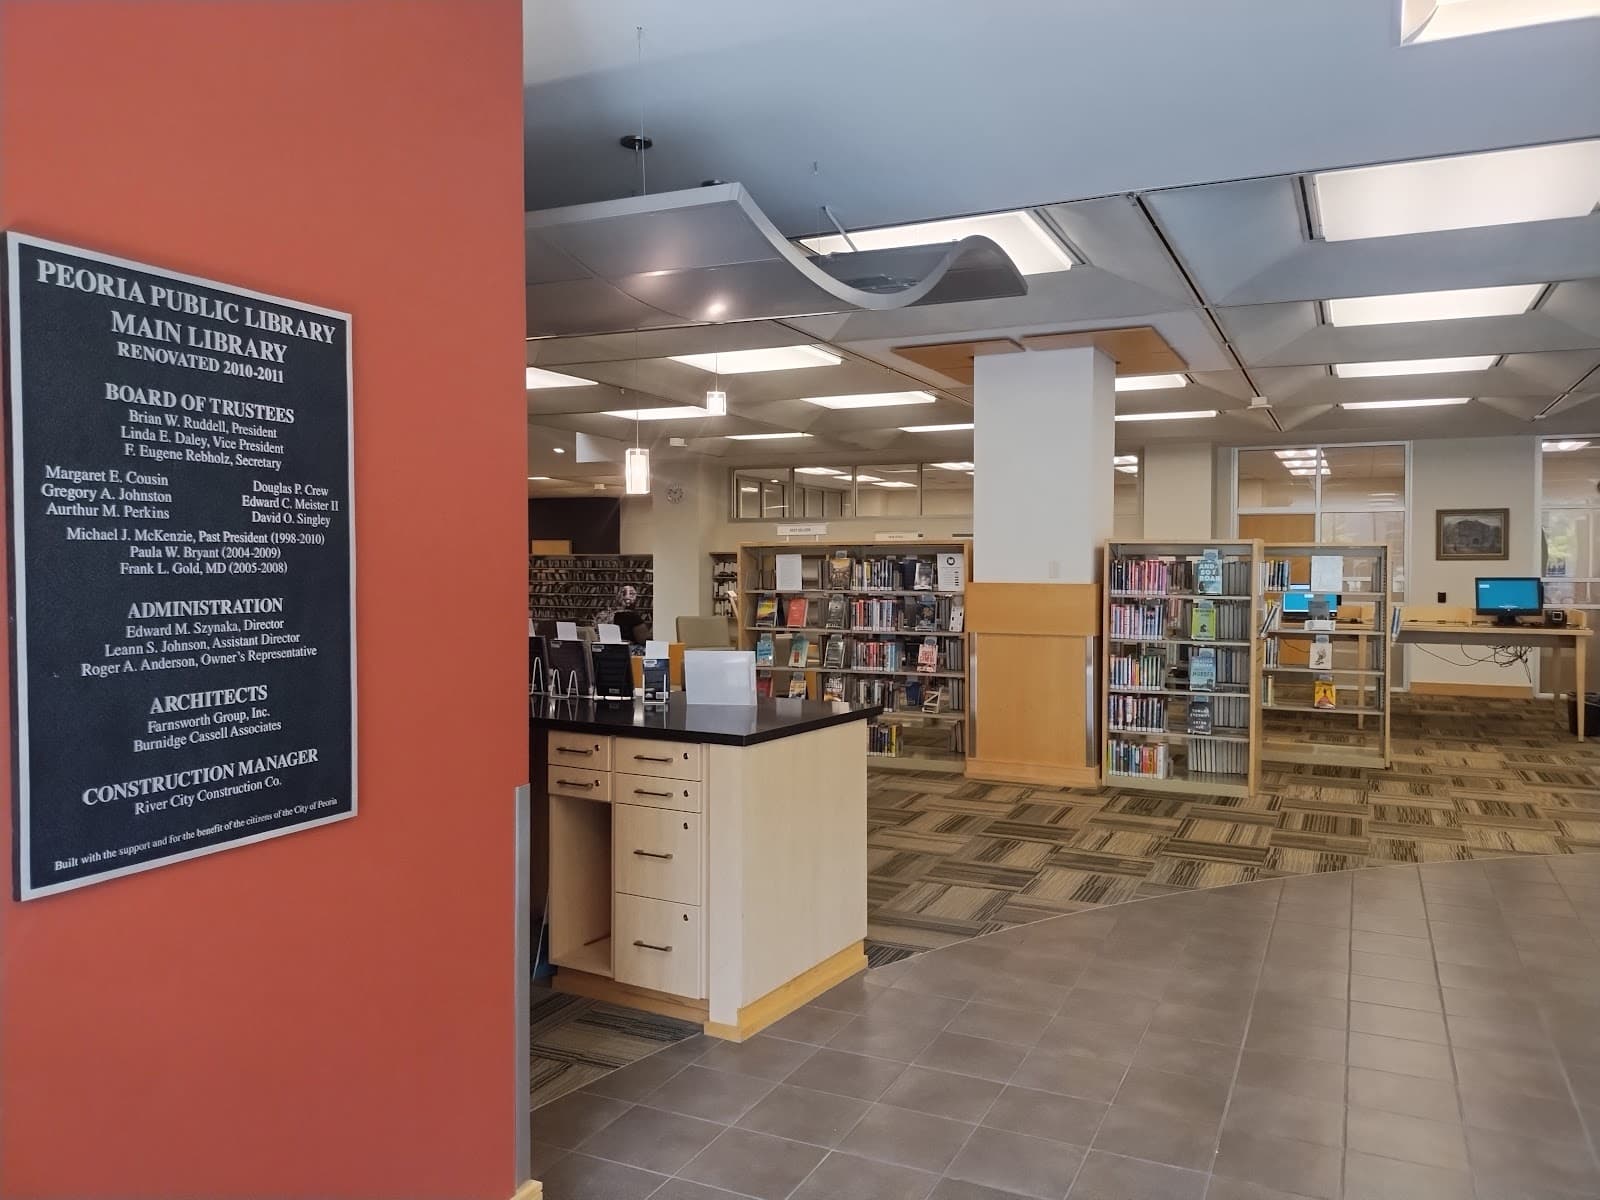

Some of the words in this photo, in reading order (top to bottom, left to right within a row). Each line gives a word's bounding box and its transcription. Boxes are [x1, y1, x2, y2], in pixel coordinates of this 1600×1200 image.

[37, 259, 145, 303] PEORIA
[150, 285, 239, 323] PUBLIC
[245, 307, 335, 343] LIBRARY
[111, 310, 181, 343] MAIN
[188, 326, 286, 363] LIBRARY
[117, 341, 220, 371] RENOVATED
[223, 360, 283, 383] 2010-2011
[105, 382, 177, 407] BOARD
[180, 393, 206, 412] OF
[209, 397, 294, 423] TRUSTEES
[128, 408, 162, 425] Brian
[163, 413, 180, 427] W.
[183, 415, 229, 434] Ruddell,
[231, 421, 277, 438] President
[120, 425, 156, 441] Linda
[158, 429, 171, 443] E.
[174, 431, 210, 449] Daley,
[212, 435, 237, 449] Vice
[238, 438, 284, 454] President
[124, 442, 136, 456] F.
[139, 444, 183, 462] Eugene
[235, 453, 282, 471] Secretary
[45, 464, 106, 484] Margaret
[108, 469, 123, 483] E.
[125, 470, 168, 486] Cousin
[252, 479, 292, 496] Douglas
[293, 482, 303, 495] P.
[304, 483, 329, 496] Crew
[40, 482, 97, 502] Gregory
[99, 487, 116, 500] A.
[118, 487, 172, 502] Johnston
[241, 494, 280, 508] Edward
[280, 497, 292, 509] C.
[294, 497, 329, 511] Meister
[330, 499, 339, 511] II
[45, 502, 99, 516] Aurthur
[101, 503, 120, 517] M.
[123, 504, 170, 519] Perkins
[251, 510, 281, 523] David
[282, 511, 295, 524] O.
[296, 512, 331, 528] Singley
[66, 526, 118, 541] Michael
[120, 528, 131, 541] J.
[134, 528, 196, 543] McKenzie,
[198, 529, 221, 543] Past
[222, 530, 268, 543] President
[270, 532, 325, 545] (1998-2010)
[129, 545, 162, 558] Paula
[164, 545, 180, 558] W.
[183, 545, 219, 561] Bryant
[220, 546, 281, 559] (2004-2009)
[119, 561, 154, 575] Frank
[156, 561, 170, 574] L.
[171, 561, 203, 575] Gold,
[205, 561, 227, 574] MD
[228, 561, 288, 574] (2005-2008)
[128, 597, 282, 618] ADMINISTRATION
[125, 623, 172, 638] Edward
[174, 622, 191, 635] M.
[243, 618, 284, 631] Director
[104, 643, 144, 657] Leann
[145, 640, 158, 654] S.
[160, 639, 210, 652] Johnson,
[212, 635, 258, 648] Assistant
[260, 632, 300, 645] Director
[80, 663, 120, 678] Roger
[122, 659, 138, 673] A.
[140, 657, 198, 671] Anderson,
[247, 645, 317, 663] Representative
[150, 684, 267, 714] ARCHITECTS
[147, 713, 211, 733] Farnsworth
[212, 711, 249, 724] Group,
[251, 706, 270, 719] Inc.
[229, 721, 282, 737] Associates
[82, 763, 234, 805] CONSTRUCTION
[238, 748, 318, 776] MANAGER
[134, 800, 168, 815] River
[169, 793, 195, 807] City
[196, 780, 262, 801] Construction
[263, 775, 282, 788] Co.
